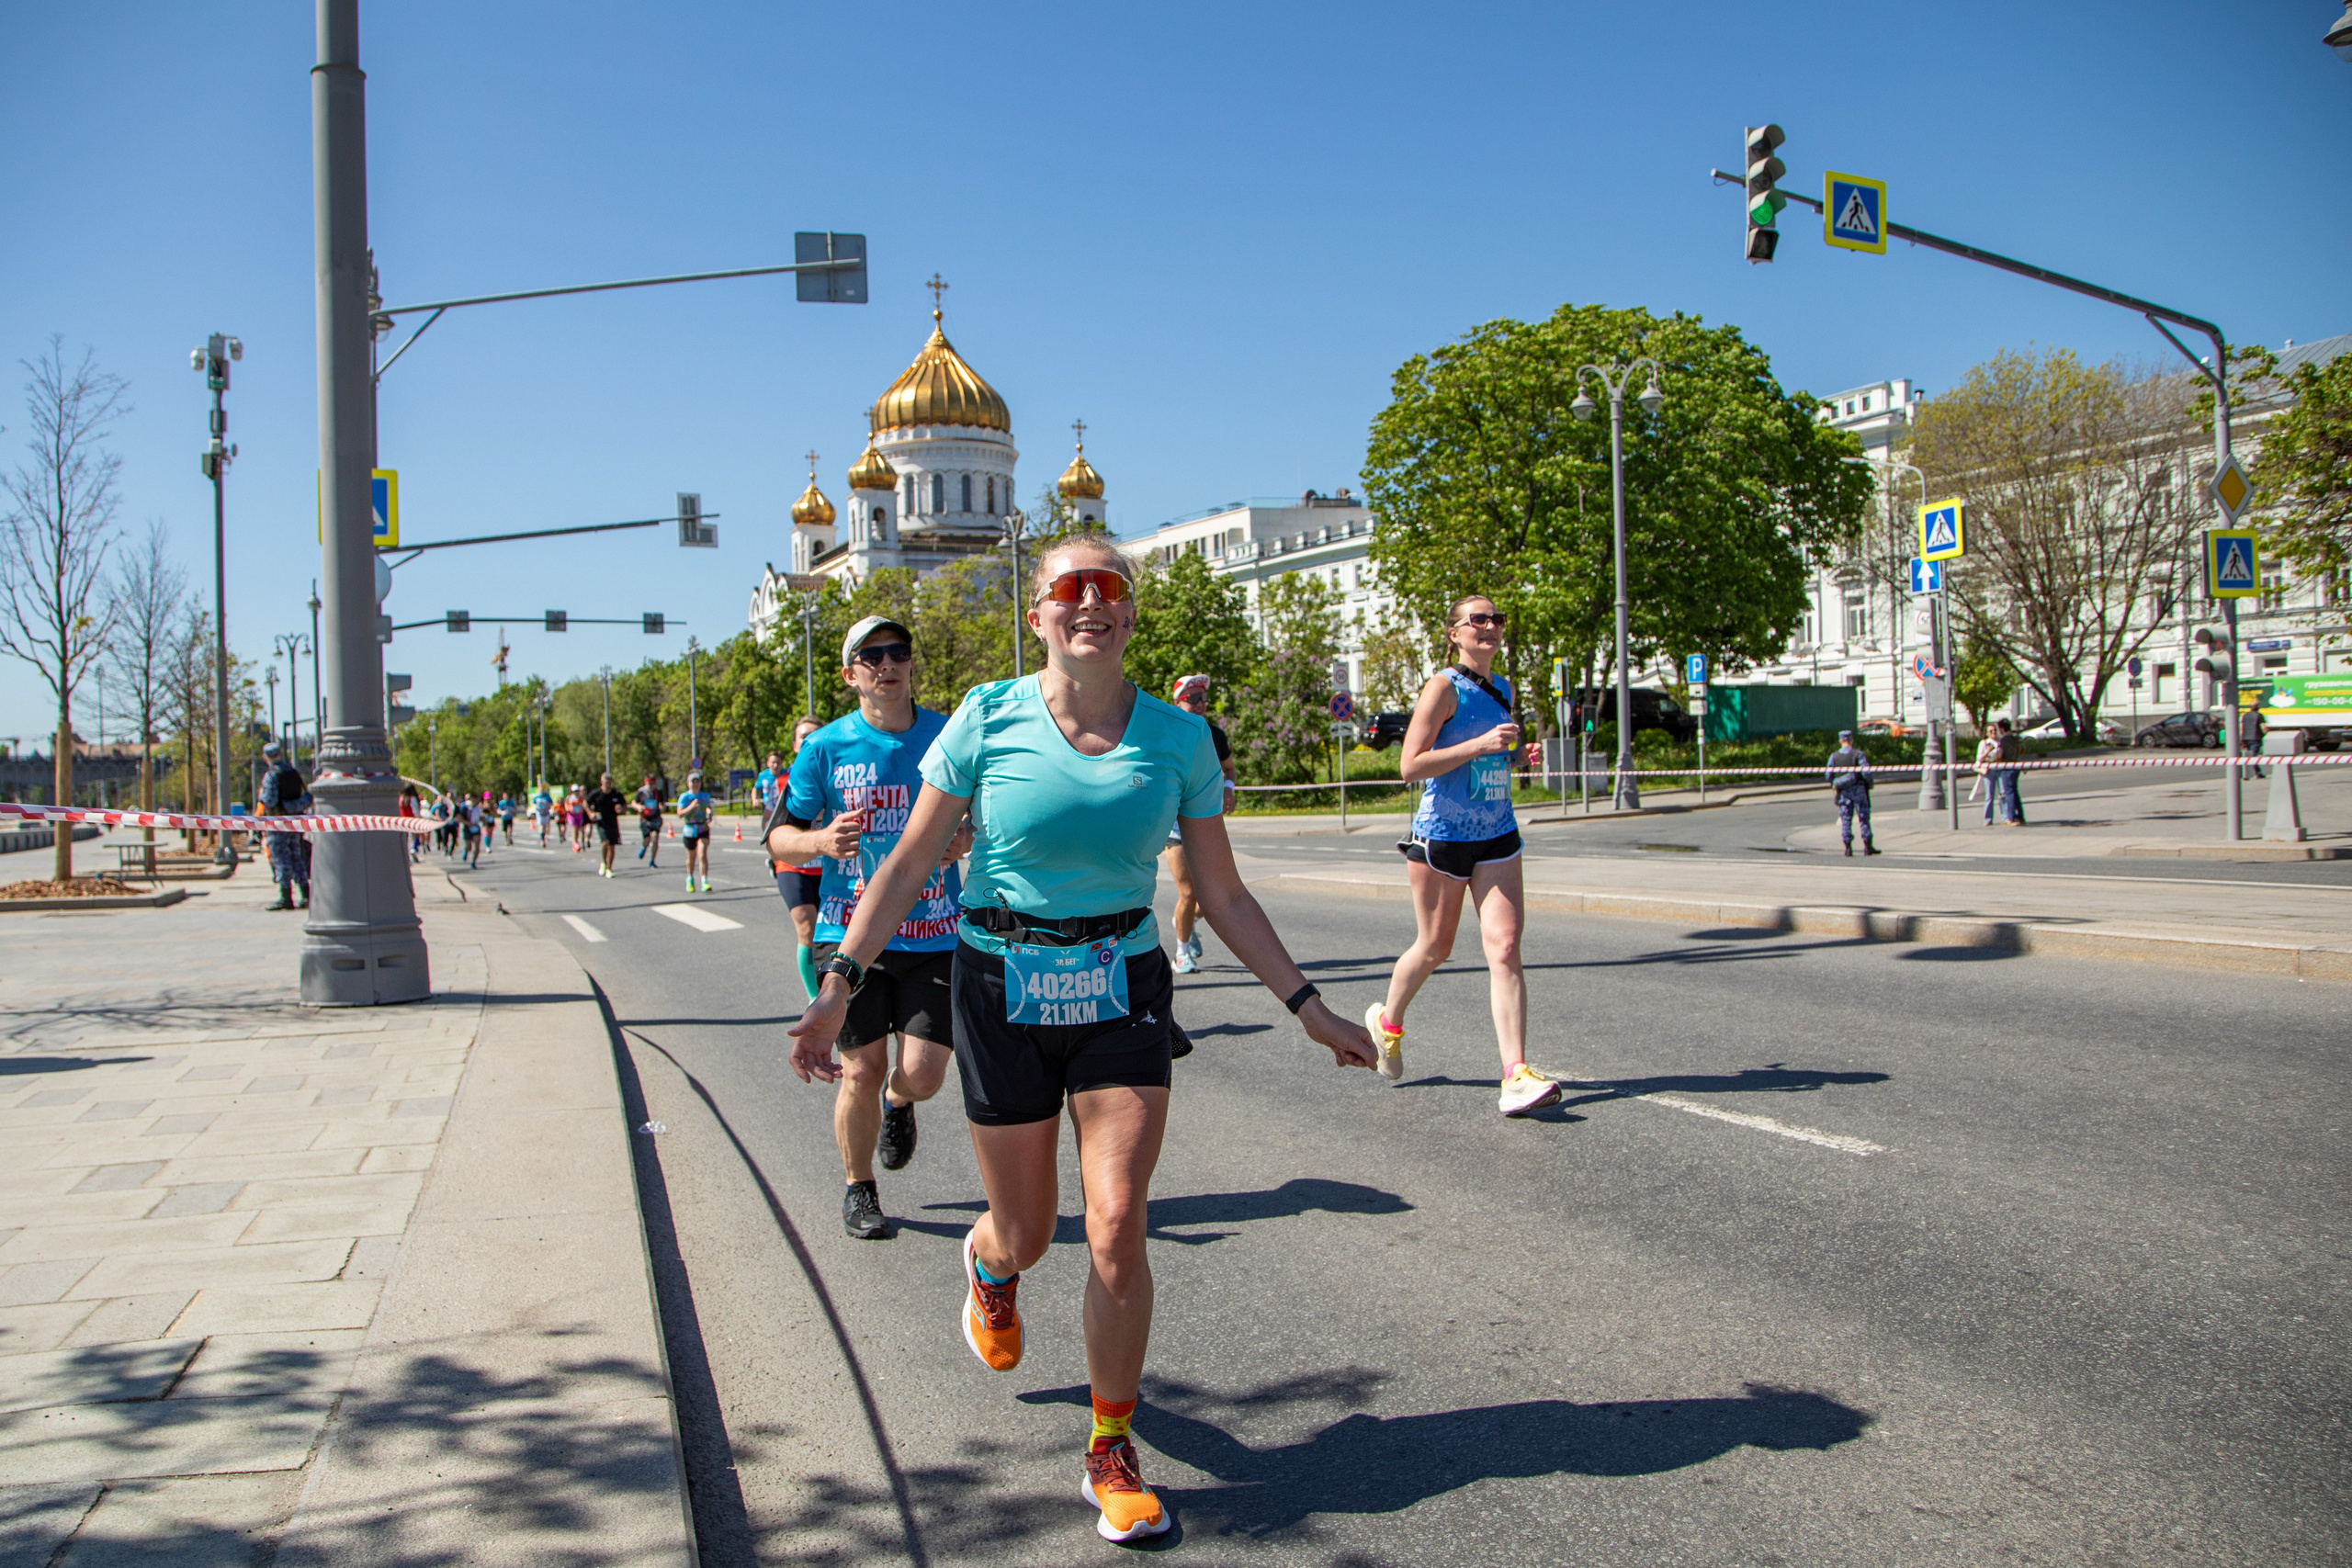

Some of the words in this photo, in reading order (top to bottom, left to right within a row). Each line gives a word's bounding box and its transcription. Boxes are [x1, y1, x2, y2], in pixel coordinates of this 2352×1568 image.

[1692, 658, 1702, 679] P
[834, 762, 877, 788] 2024
[842, 785, 910, 810] #МЕЧТА
[1022, 947, 1039, 955] ПСБ
[1027, 967, 1107, 1000] 40266
